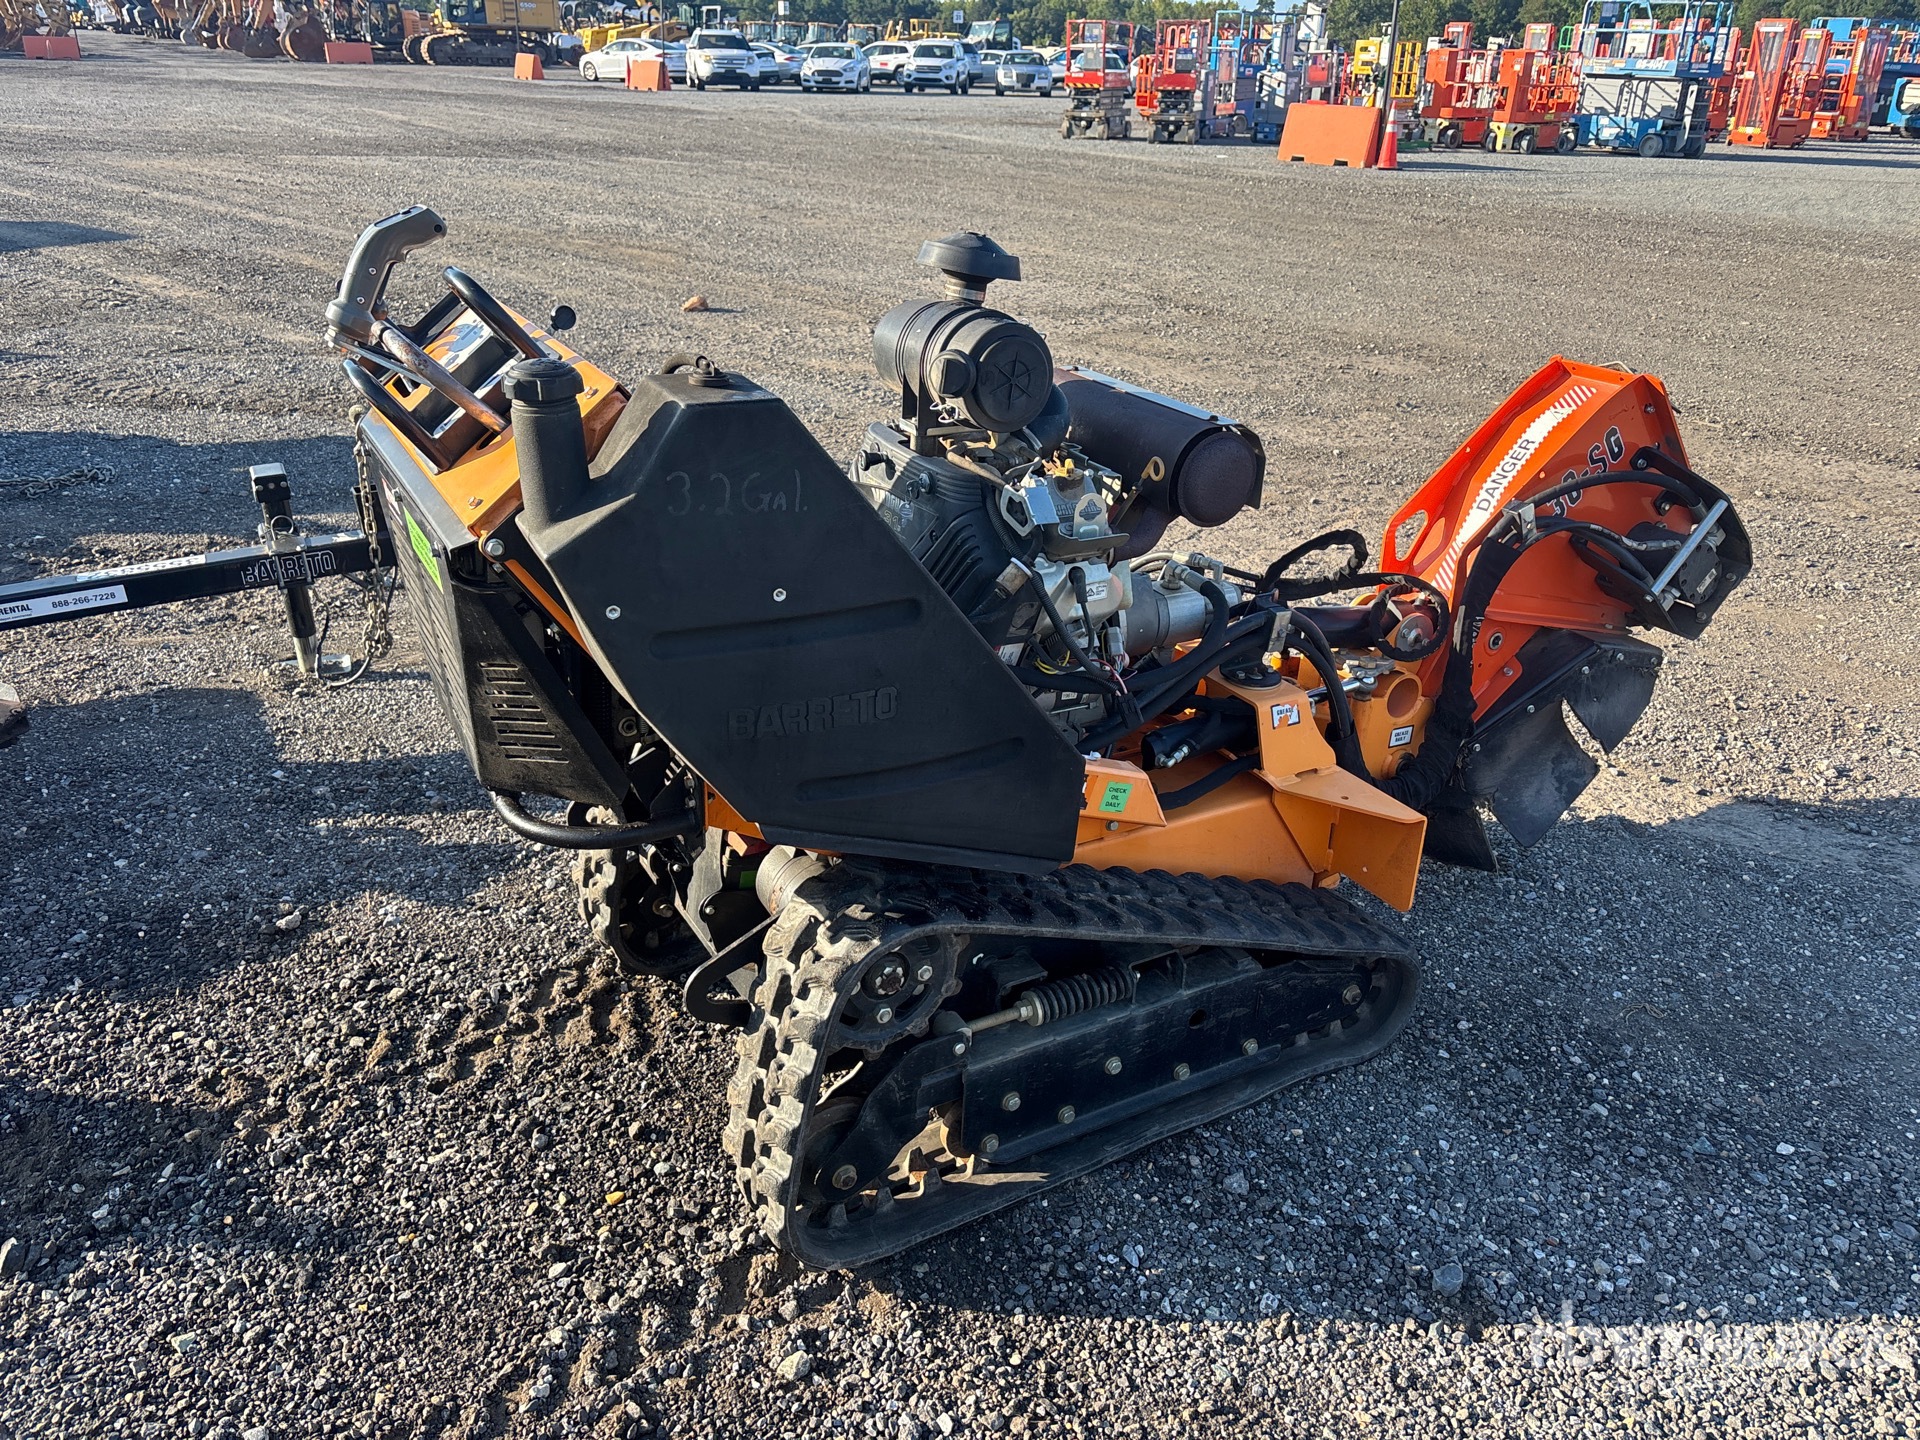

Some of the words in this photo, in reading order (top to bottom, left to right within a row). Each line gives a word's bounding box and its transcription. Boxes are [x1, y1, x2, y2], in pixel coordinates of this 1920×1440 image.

[1475, 438, 1536, 512] DANGER
[51, 591, 116, 609] 888-266-7228
[727, 685, 899, 740] BARRETO
[1108, 786, 1127, 794] CHECK
